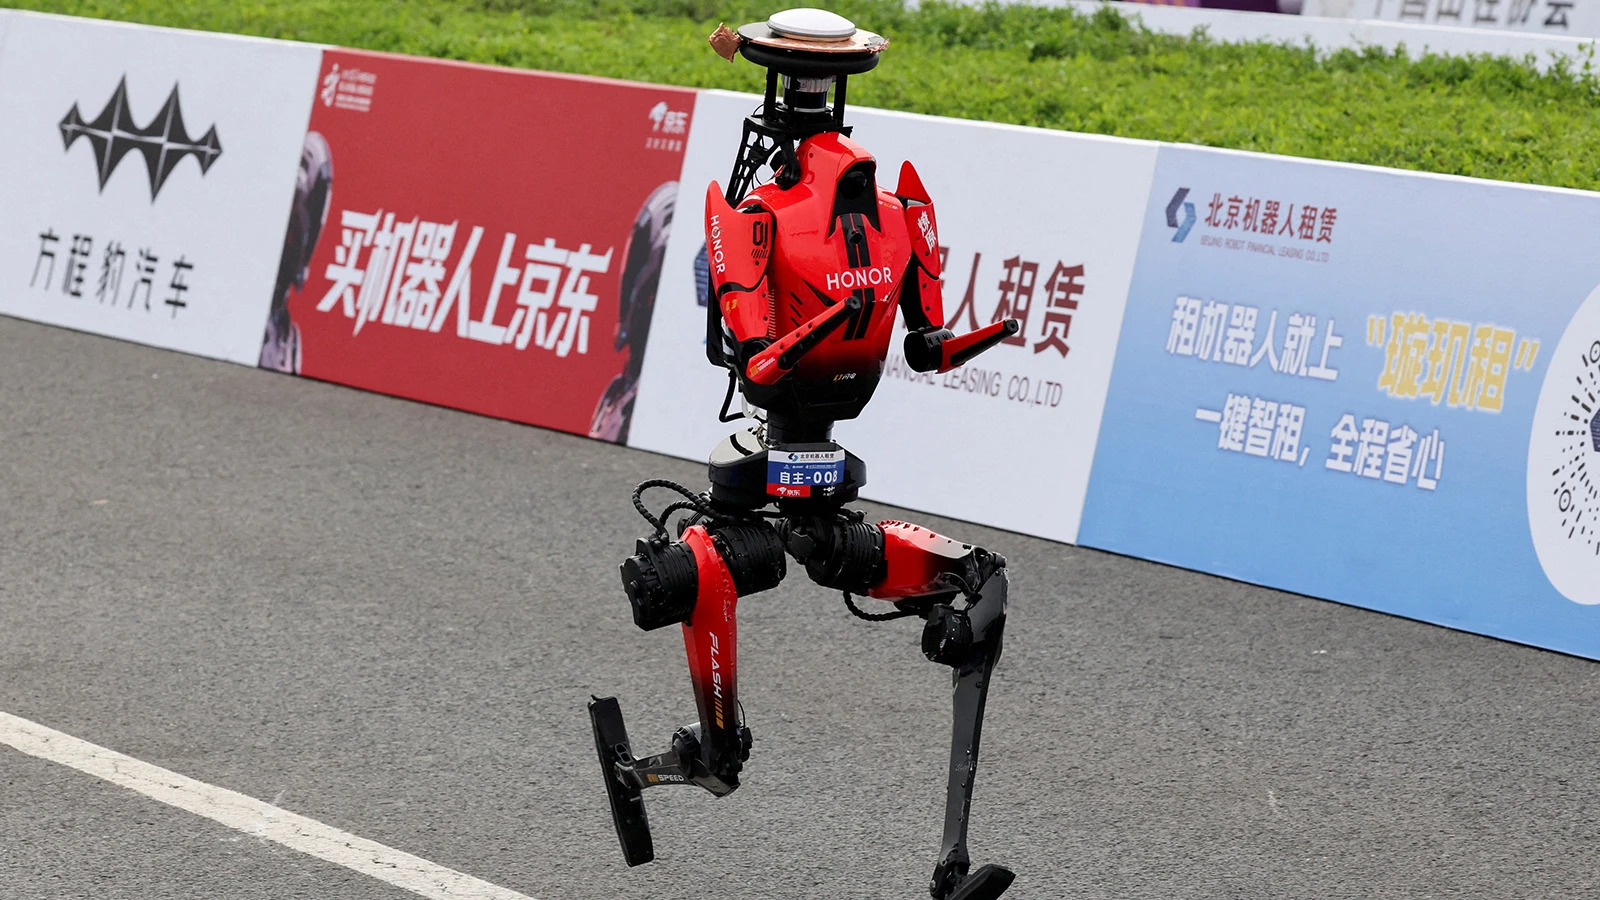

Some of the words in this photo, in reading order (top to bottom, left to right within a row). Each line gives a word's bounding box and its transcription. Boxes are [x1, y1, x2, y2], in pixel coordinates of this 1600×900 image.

[710, 214, 726, 274] HONOR
[1205, 193, 1337, 243] 北京机器人租赁
[29, 227, 195, 318] 方程豹汽车
[315, 207, 614, 357] 买机器人上京东
[826, 267, 893, 291] HONOR
[1166, 295, 1343, 381] 租机器人就上
[709, 631, 723, 699] FLASH
[657, 774, 685, 782] SPEED
